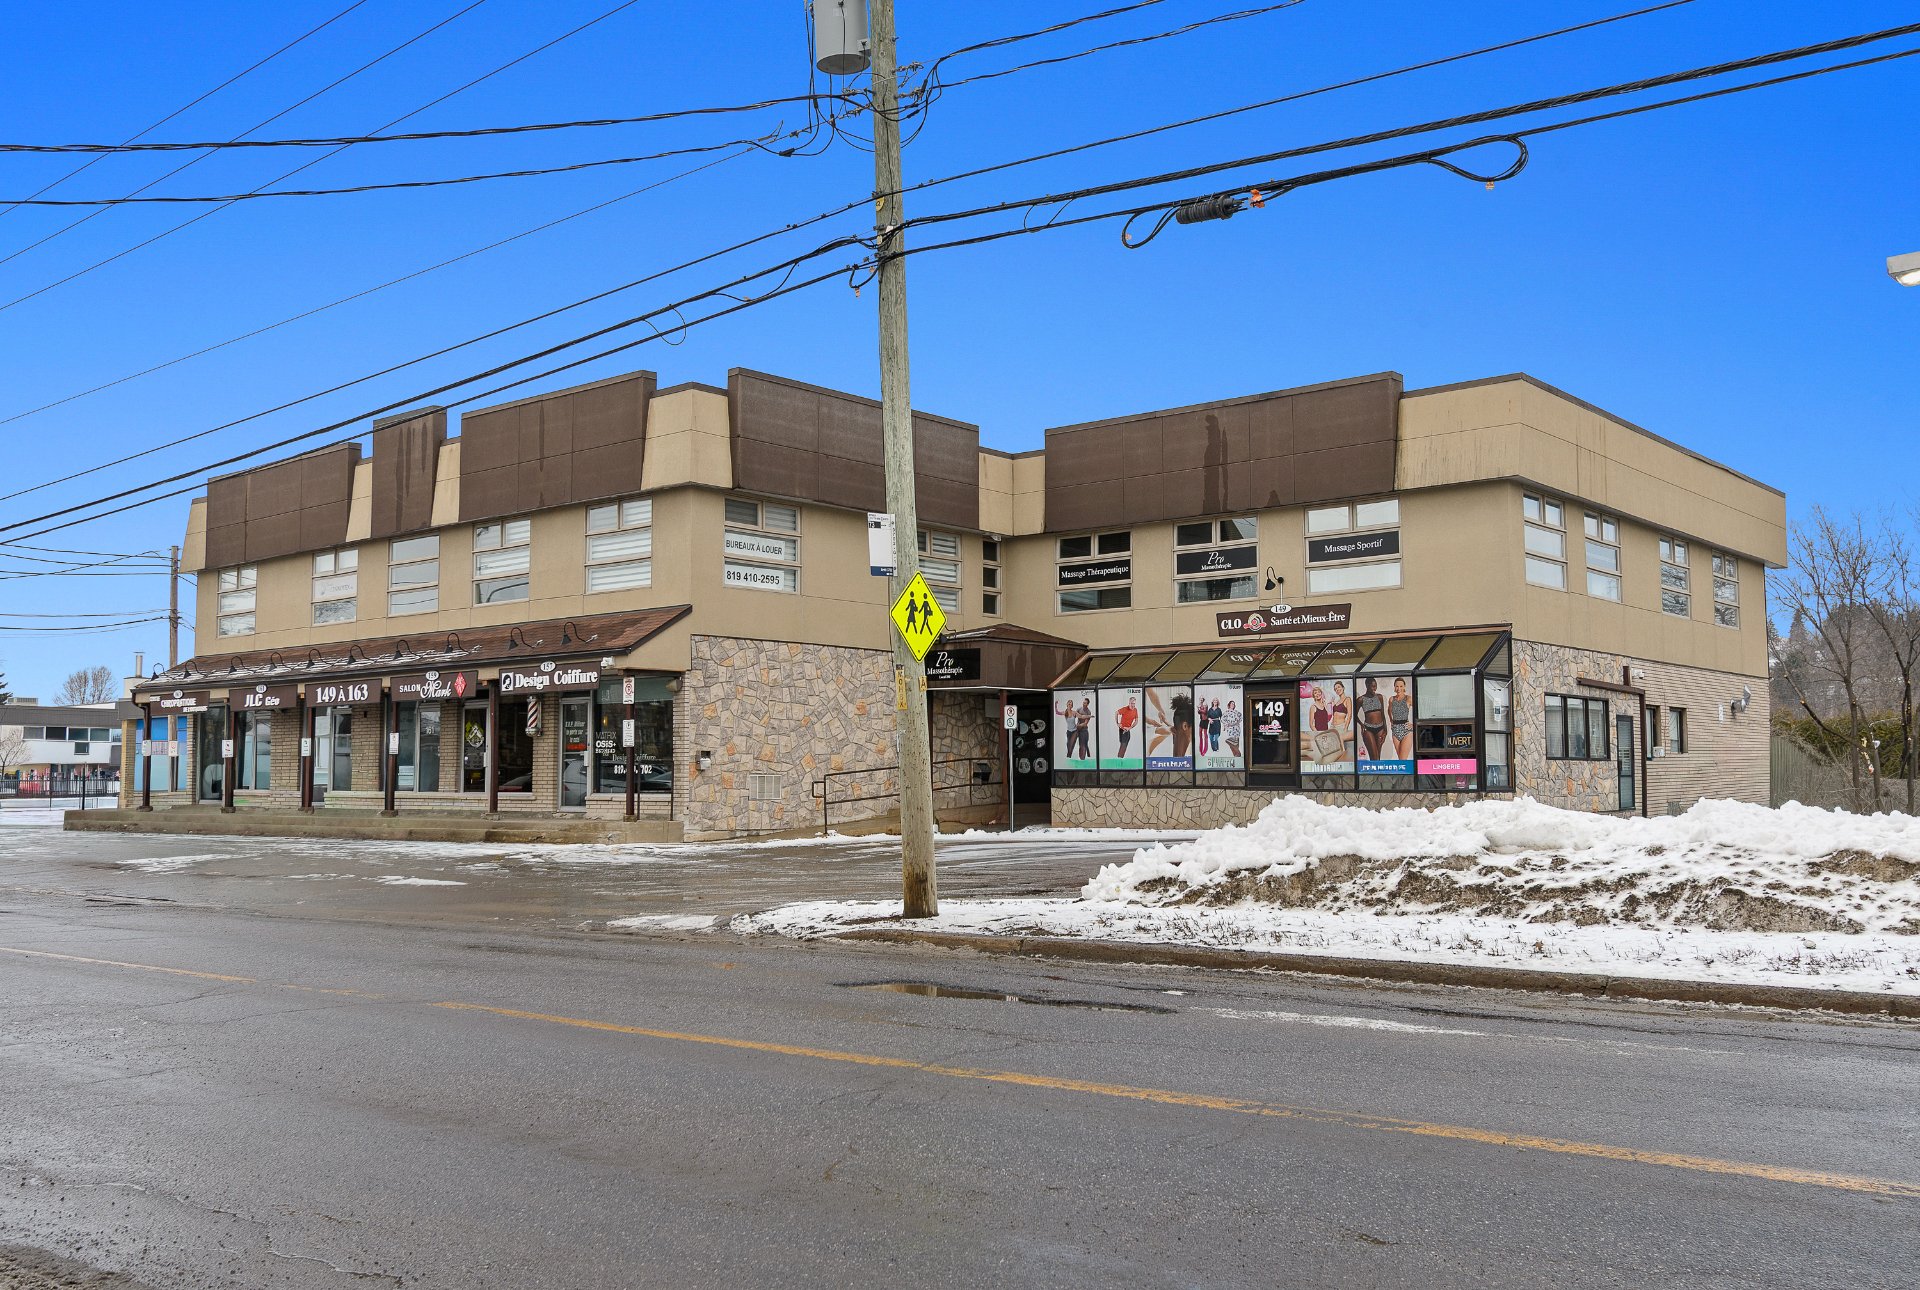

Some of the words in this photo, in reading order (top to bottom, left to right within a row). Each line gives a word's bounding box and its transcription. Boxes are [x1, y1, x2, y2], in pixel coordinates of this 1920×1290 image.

[726, 540, 755, 551] BUREAUX
[756, 543, 761, 551] À
[762, 545, 783, 555] LOUER
[1325, 545, 1355, 553] Massage
[1357, 538, 1383, 550] Sportif
[1208, 551, 1225, 564] Pro
[726, 570, 741, 581] 819
[743, 572, 780, 585] 410-2595
[1061, 570, 1086, 579] Massage
[1087, 565, 1129, 576] Thérapeutique
[1275, 605, 1287, 613] 149
[1220, 618, 1242, 630] CLO
[1270, 616, 1292, 627] Santé
[1293, 617, 1301, 625] et
[1301, 610, 1346, 625] Mieux-Être
[543, 662, 554, 670] 157
[935, 651, 955, 667] Pro
[927, 666, 963, 676] Massothérapie
[515, 671, 550, 690] Design
[553, 669, 598, 685] Coiffure
[315, 686, 336, 704] 149
[337, 685, 346, 702] À
[347, 683, 369, 702] 163
[399, 683, 420, 693] SALON
[420, 680, 452, 699] Mark
[244, 693, 262, 707] JLC
[265, 695, 280, 706] Géo
[1256, 701, 1284, 717] 149
[595, 731, 617, 740] MATRIX
[1432, 763, 1461, 771] LINGERIE
